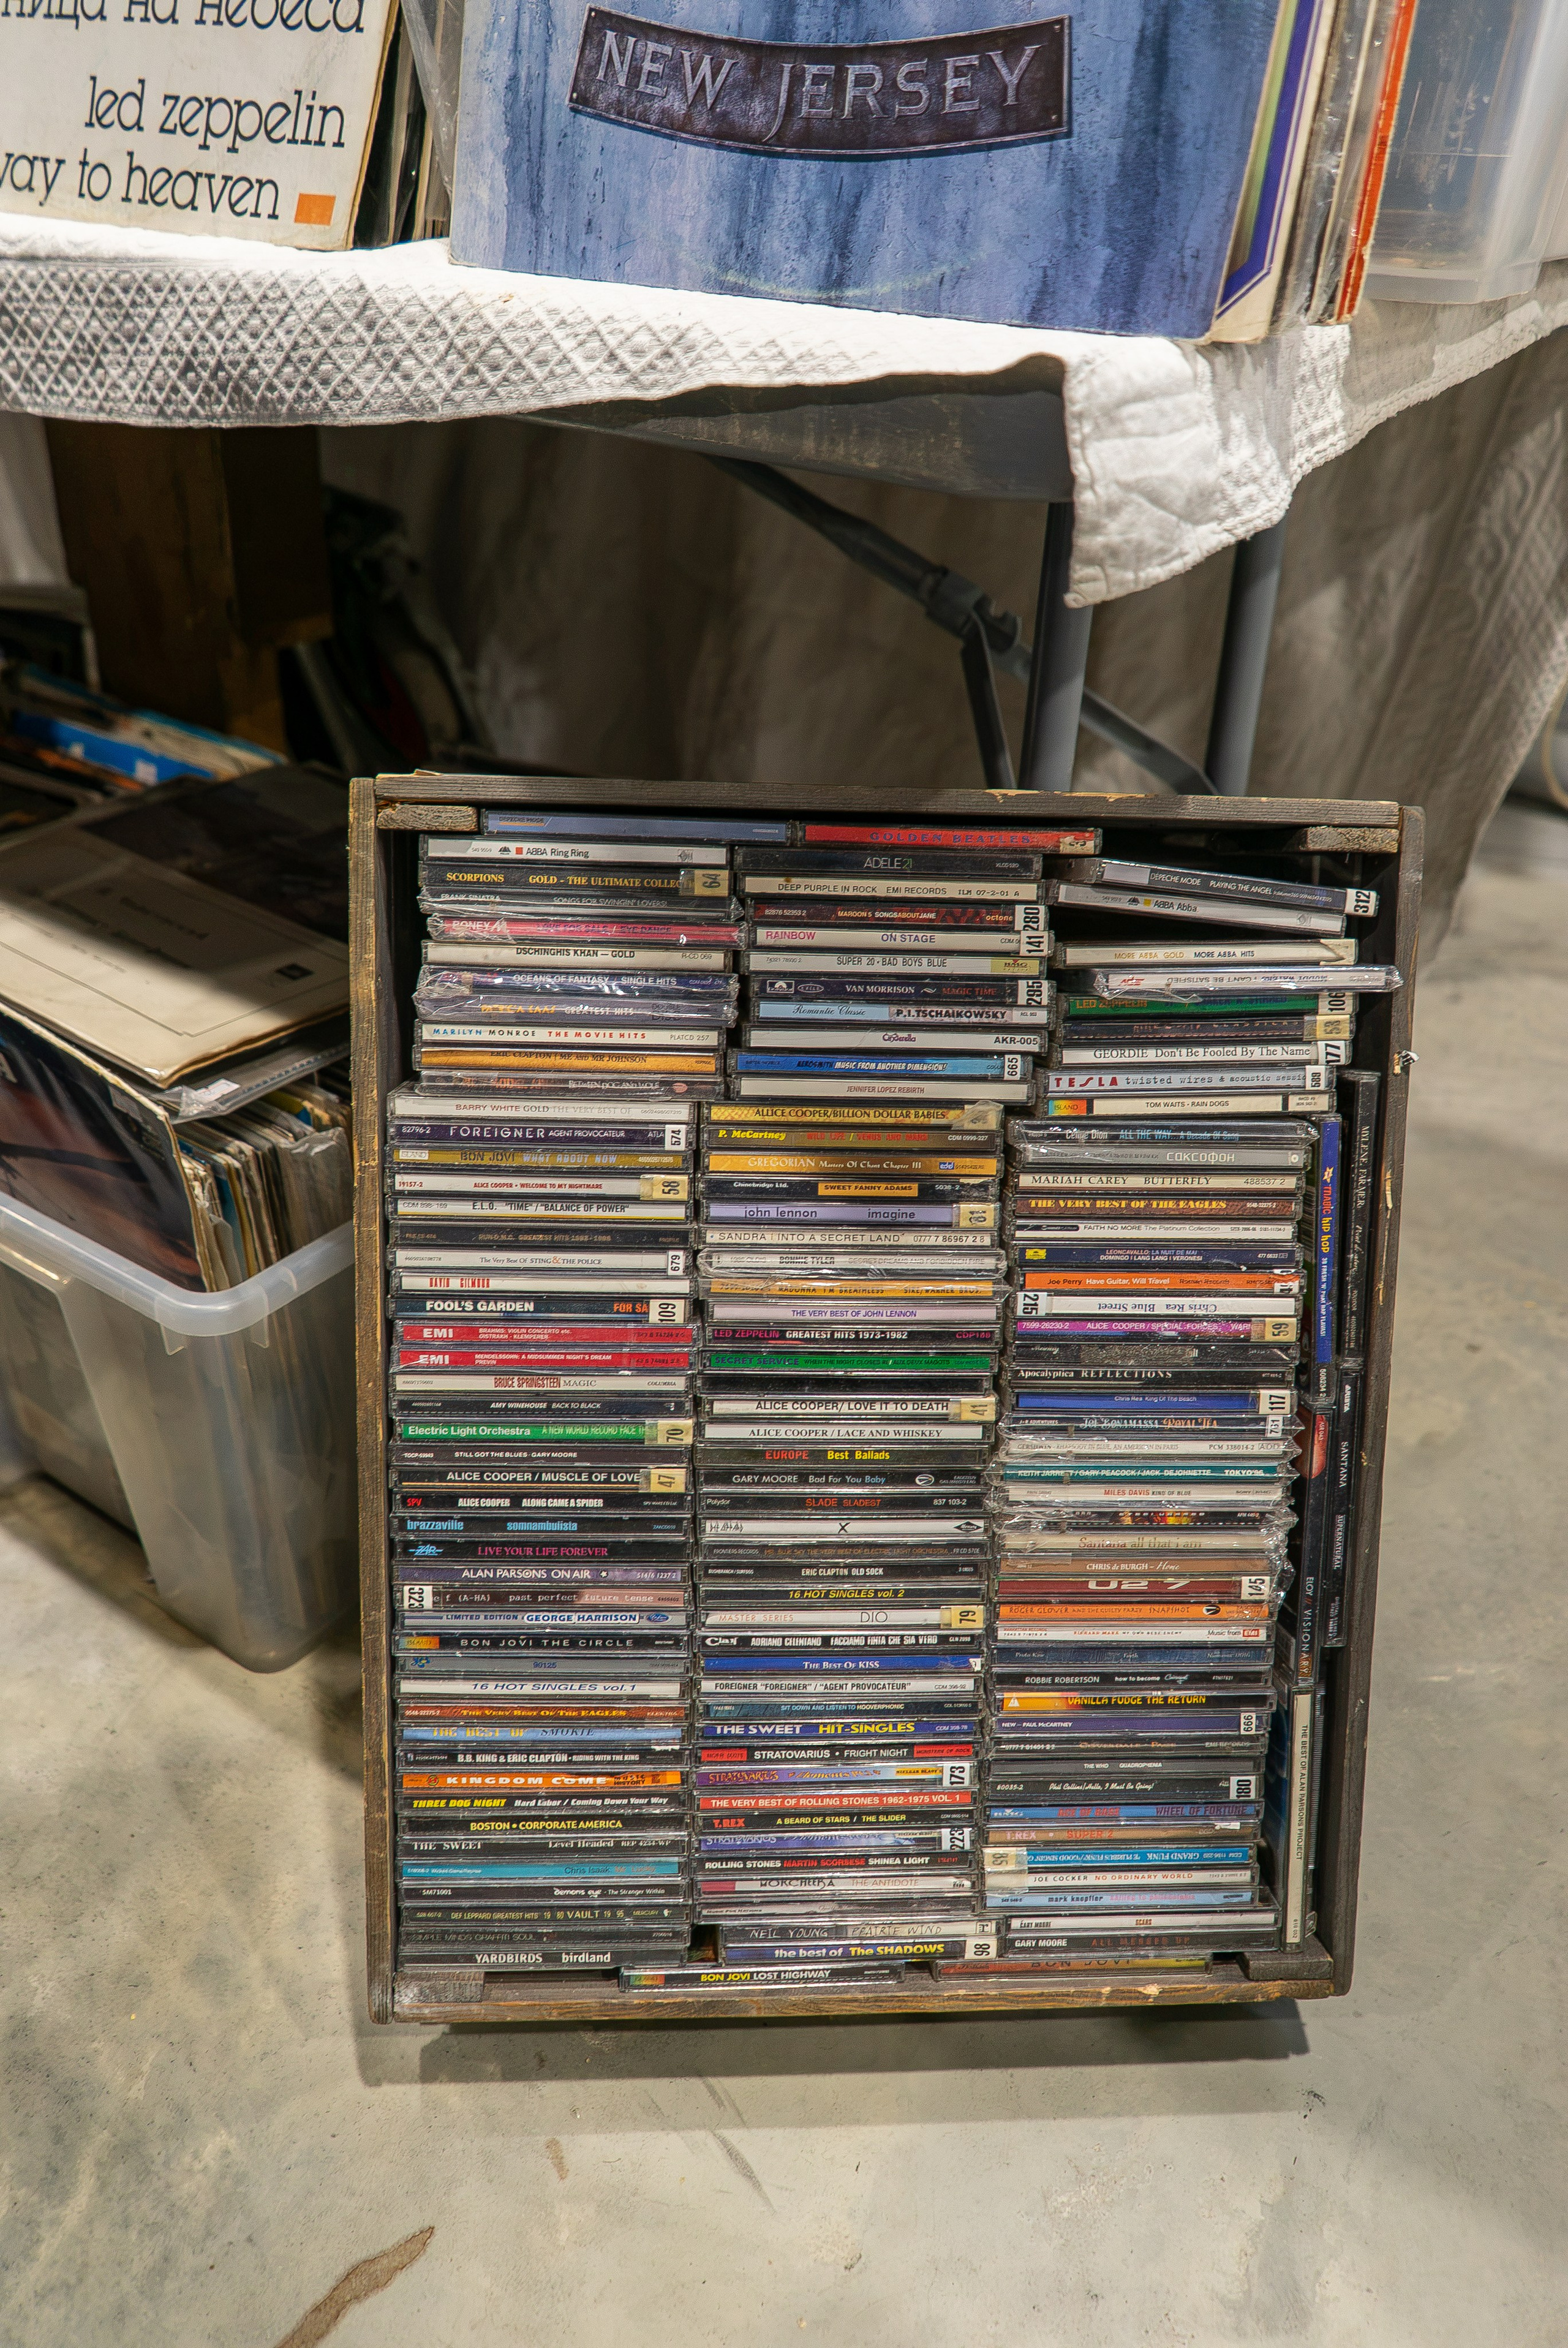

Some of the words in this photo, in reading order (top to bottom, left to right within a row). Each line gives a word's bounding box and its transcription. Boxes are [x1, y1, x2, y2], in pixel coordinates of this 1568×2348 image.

[595, 29, 739, 111] NEW
[761, 44, 1043, 142] JERSEY
[85, 76, 146, 132] led
[159, 91, 346, 154] zeppelin
[78, 148, 111, 202] to
[121, 151, 280, 221] heaven
[550, 848, 569, 858] Ring
[570, 848, 590, 858] Ring
[778, 883, 802, 892] DEEP
[804, 884, 839, 893] PURPLE
[853, 885, 877, 894] ROCK
[886, 886, 902, 894] EMI
[905, 886, 947, 895] RECORDS
[1353, 890, 1370, 913] 312
[1024, 906, 1040, 931] 280
[766, 931, 816, 940] RAINBOW
[881, 933, 897, 943] ON
[900, 934, 936, 943] STAGE
[1025, 934, 1044, 954] 141
[516, 948, 571, 957] DSCHINGHIS
[573, 948, 599, 957] KHAN
[611, 949, 635, 958] GOLD
[1027, 981, 1043, 1005] 295
[993, 1036, 1038, 1046] AKR-005
[1093, 1048, 1148, 1059] GEORDIE
[1155, 1047, 1183, 1057] Don't
[1186, 1048, 1200, 1057] Be
[1202, 1046, 1238, 1057] Fooled
[1241, 1047, 1256, 1059] By
[1258, 1046, 1277, 1056] The
[1280, 1046, 1310, 1056] Name
[1325, 1043, 1342, 1064] 177
[1007, 1057, 1019, 1076] 665
[450, 1127, 545, 1138] FOREIGNER
[575, 1130, 625, 1138] PROVOCATEUR
[671, 1130, 682, 1147] 574
[732, 1130, 786, 1141] McCartney
[1031, 1176, 1084, 1184] MARIAH
[1088, 1176, 1129, 1185] CAREY
[1144, 1176, 1212, 1185] BUTTERFLY
[744, 1207, 771, 1218] john
[776, 1207, 818, 1218] lennon
[867, 1208, 916, 1220] imagine
[1322, 1217, 1333, 1233] hip
[1321, 1234, 1334, 1253] hop
[671, 1255, 680, 1272] 679
[1063, 1278, 1082, 1286] Perry
[1108, 1277, 1130, 1286] Guitar,
[426, 1301, 474, 1312] FOOL'S
[477, 1301, 535, 1312] GARDEN
[614, 1303, 633, 1313] FOR
[1022, 1293, 1039, 1315] 215
[1098, 1302, 1128, 1312] Street
[1131, 1303, 1155, 1312] Blue
[1166, 1304, 1185, 1312] Rea
[1188, 1303, 1217, 1312] Chris
[658, 1302, 676, 1323] 109
[423, 1328, 453, 1338] EMI
[786, 1331, 831, 1339] GREATEST
[834, 1331, 855, 1339] HITS
[858, 1331, 908, 1339] 1973-1982
[1268, 1394, 1286, 1411] 117
[408, 1425, 448, 1435] Electric
[451, 1425, 477, 1438] Light
[478, 1425, 530, 1436] Orchestra
[666, 1429, 684, 1443] 70
[766, 1450, 809, 1460] EUROPE
[827, 1450, 849, 1460] Best
[855, 1450, 890, 1460] Ballads
[1340, 1441, 1349, 1487] SANTANA
[447, 1472, 481, 1481] ALICE
[483, 1472, 532, 1481] COOPER
[541, 1472, 590, 1482] MUSCLE
[592, 1472, 608, 1482] OF
[611, 1472, 641, 1482] LOVE
[658, 1475, 676, 1488] 47
[407, 1520, 464, 1530] brazzaville
[507, 1521, 578, 1531] somnambulista
[1088, 1580, 1148, 1590] U2
[1166, 1580, 1191, 1589] 7
[804, 1590, 826, 1598] HOT
[829, 1590, 874, 1598] SINGLES
[877, 1590, 894, 1598] vol.
[897, 1590, 905, 1598] 2
[526, 1613, 573, 1623] GEORGE
[577, 1613, 637, 1622] HARRISON
[860, 1611, 888, 1623] DIO
[959, 1610, 976, 1624] 79
[1298, 1609, 1311, 1674] VISIONARY
[1068, 1695, 1109, 1705] VANILLA
[1111, 1695, 1142, 1704] FUDGE
[1145, 1694, 1164, 1704] THE
[1167, 1694, 1206, 1704] RETURN
[447, 1776, 543, 1785] KINGDOM
[551, 1775, 607, 1784] COME
[950, 1766, 965, 1786] 173
[710, 1799, 729, 1807] THE
[731, 1799, 756, 1807] VERY
[758, 1798, 782, 1806] BEST
[784, 1797, 798, 1806] OF
[799, 1796, 840, 1805] ROLLING
[842, 1795, 880, 1805] STONES
[881, 1795, 930, 1805] 1962-1975
[932, 1794, 952, 1803] VOL.
[470, 1821, 510, 1831] BOSTON
[519, 1820, 577, 1830] CORPORATE
[578, 1819, 622, 1829] AMERICA
[1015, 1938, 1037, 1947] GARY
[1038, 1938, 1068, 1946] MOORE
[774, 1949, 797, 1958] the
[799, 1947, 826, 1957] best
[828, 1947, 842, 1957] of
[849, 1946, 874, 1956] The
[876, 1944, 944, 1955] SHADOWS
[475, 1952, 543, 1964] YARDBIRDS
[562, 1952, 611, 1963] birdland
[700, 1972, 725, 1982] BON
[726, 1971, 750, 1981] JOVI
[753, 1971, 778, 1980] LOST
[781, 1969, 831, 1979] HIGHWAY
